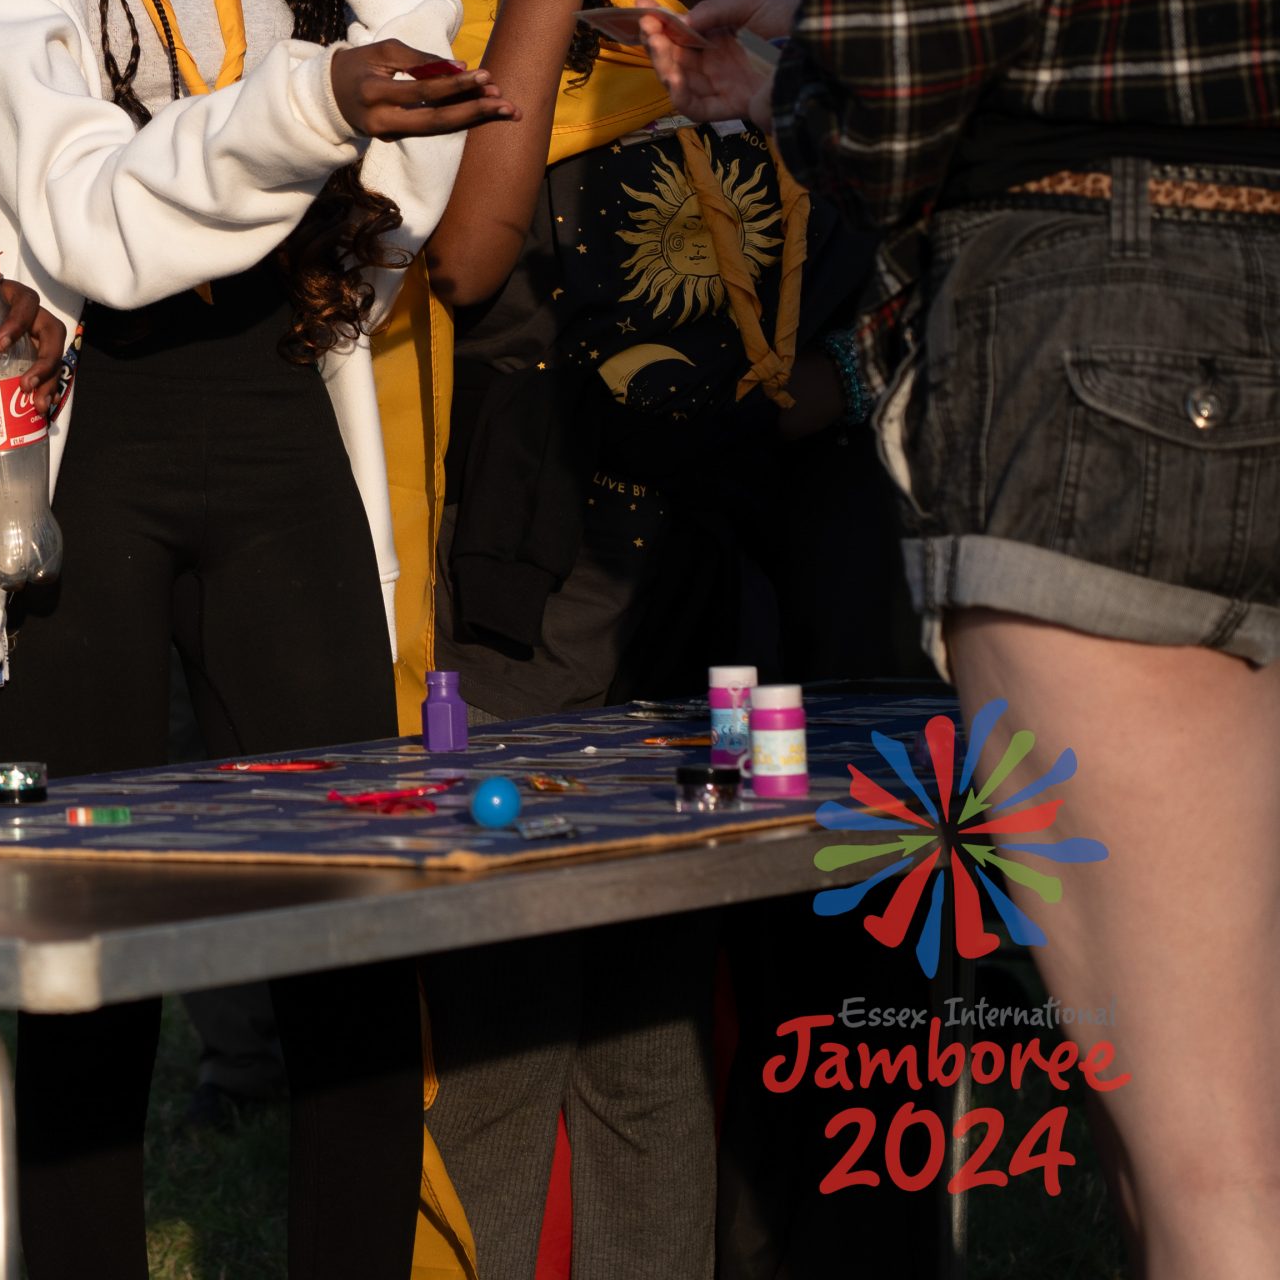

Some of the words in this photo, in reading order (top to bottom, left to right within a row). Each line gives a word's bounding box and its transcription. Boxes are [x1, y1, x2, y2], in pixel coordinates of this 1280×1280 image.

[740, 130, 768, 151] MOO
[593, 471, 625, 494] LIVE
[632, 483, 647, 498] BY
